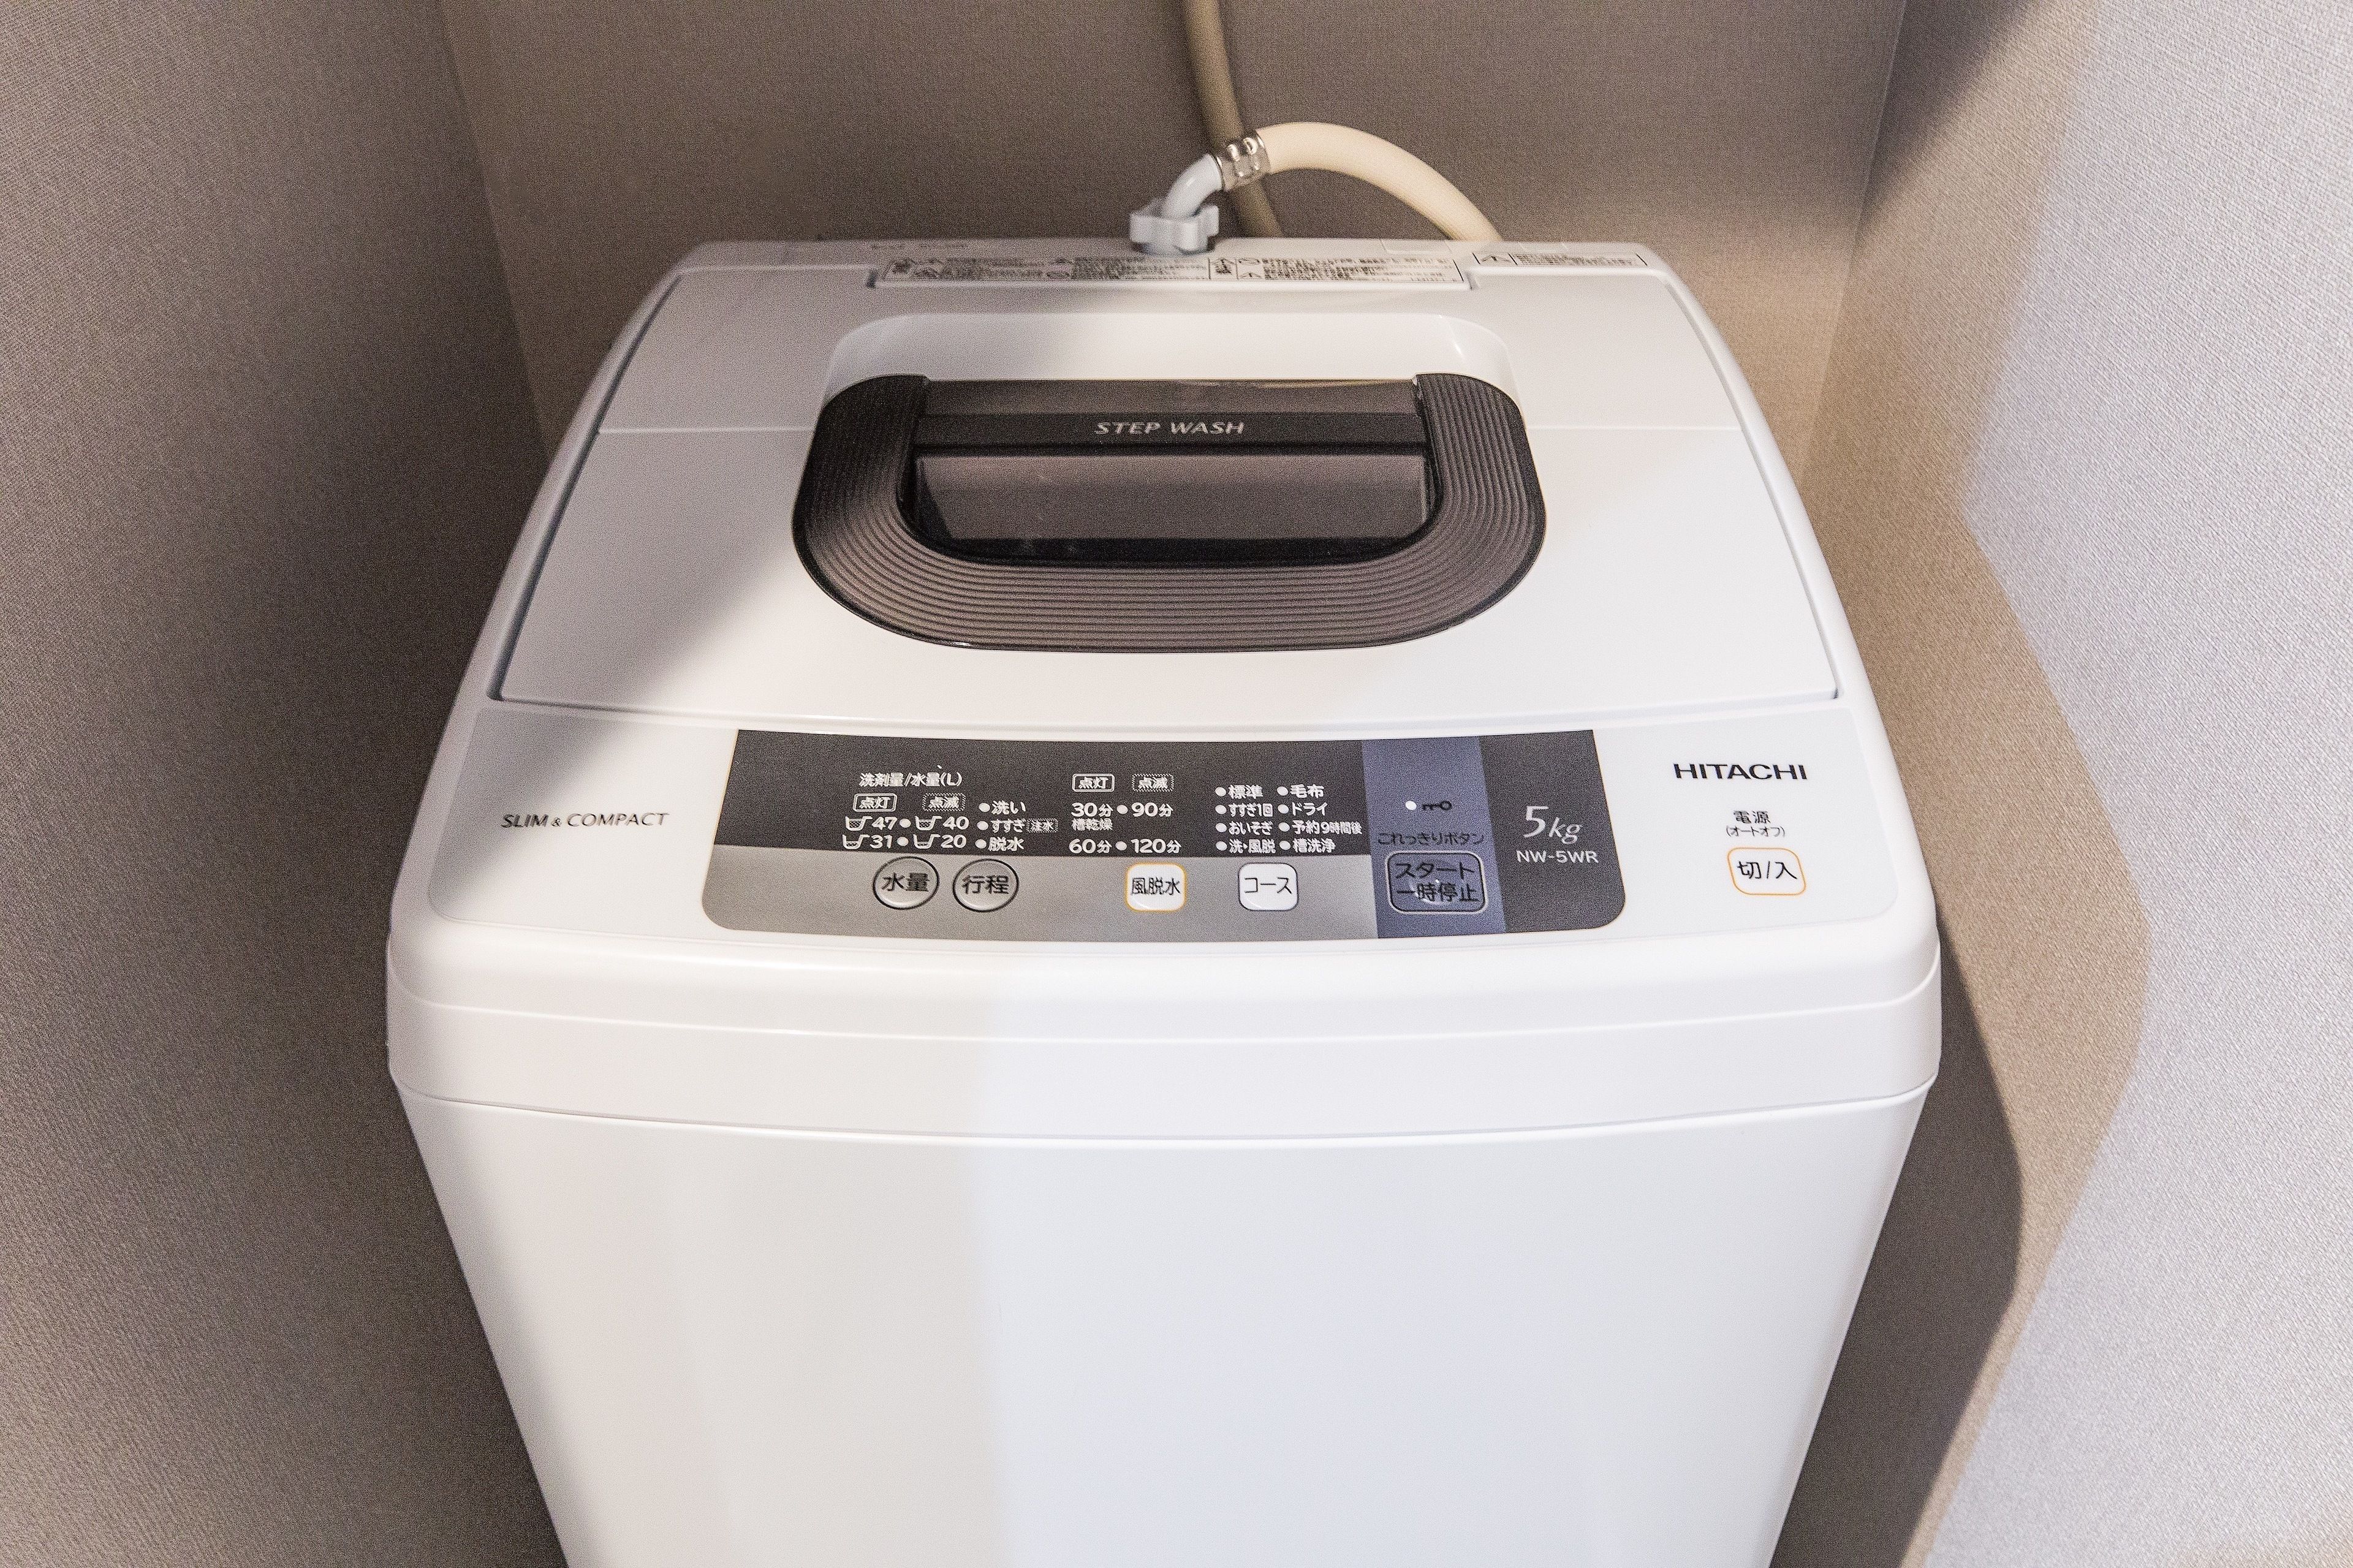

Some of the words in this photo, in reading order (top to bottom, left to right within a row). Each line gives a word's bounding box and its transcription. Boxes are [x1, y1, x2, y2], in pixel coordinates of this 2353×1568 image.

[1094, 422, 1161, 434] STEP
[1170, 422, 1245, 434] WASH
[859, 771, 963, 787] 洗剤量/水量(L)
[1673, 763, 1808, 780] HITACHI
[1078, 777, 1108, 789] 点灯
[1137, 776, 1169, 789] 点滅
[1228, 784, 1264, 799] 標準
[1290, 784, 1325, 798] 毛布
[860, 796, 891, 809] 点灯
[928, 797, 960, 809] 点滅
[991, 800, 1026, 814] 洗い
[1071, 802, 1113, 817] 30分
[1131, 802, 1173, 817] 90分
[1292, 802, 1328, 816] ドライ
[501, 814, 548, 828] SLIM
[551, 817, 563, 827] &
[566, 812, 670, 827] COMPACT
[871, 817, 898, 830] 47
[942, 816, 969, 830] 40
[1523, 806, 1549, 838] 5
[1548, 818, 1583, 844] kg
[1733, 811, 1771, 824] 電源
[990, 819, 1025, 833] すすぎ
[1228, 821, 1273, 835] おいそぎ
[869, 835, 892, 849] 31
[940, 835, 967, 849] 20
[988, 836, 1024, 852] 脱水
[1069, 838, 1112, 854] 60分
[1131, 838, 1182, 854] 120分
[1292, 838, 1336, 854] 槽洗浄
[1516, 849, 1599, 864] NW-5WR
[1396, 862, 1475, 879] スタート
[1737, 861, 1797, 879] 切/入
[881, 872, 929, 893] 水量
[962, 874, 1009, 895] 行程
[1131, 877, 1181, 895] 風脱水
[1244, 877, 1292, 894] コース
[1397, 882, 1479, 904] 一時停止
